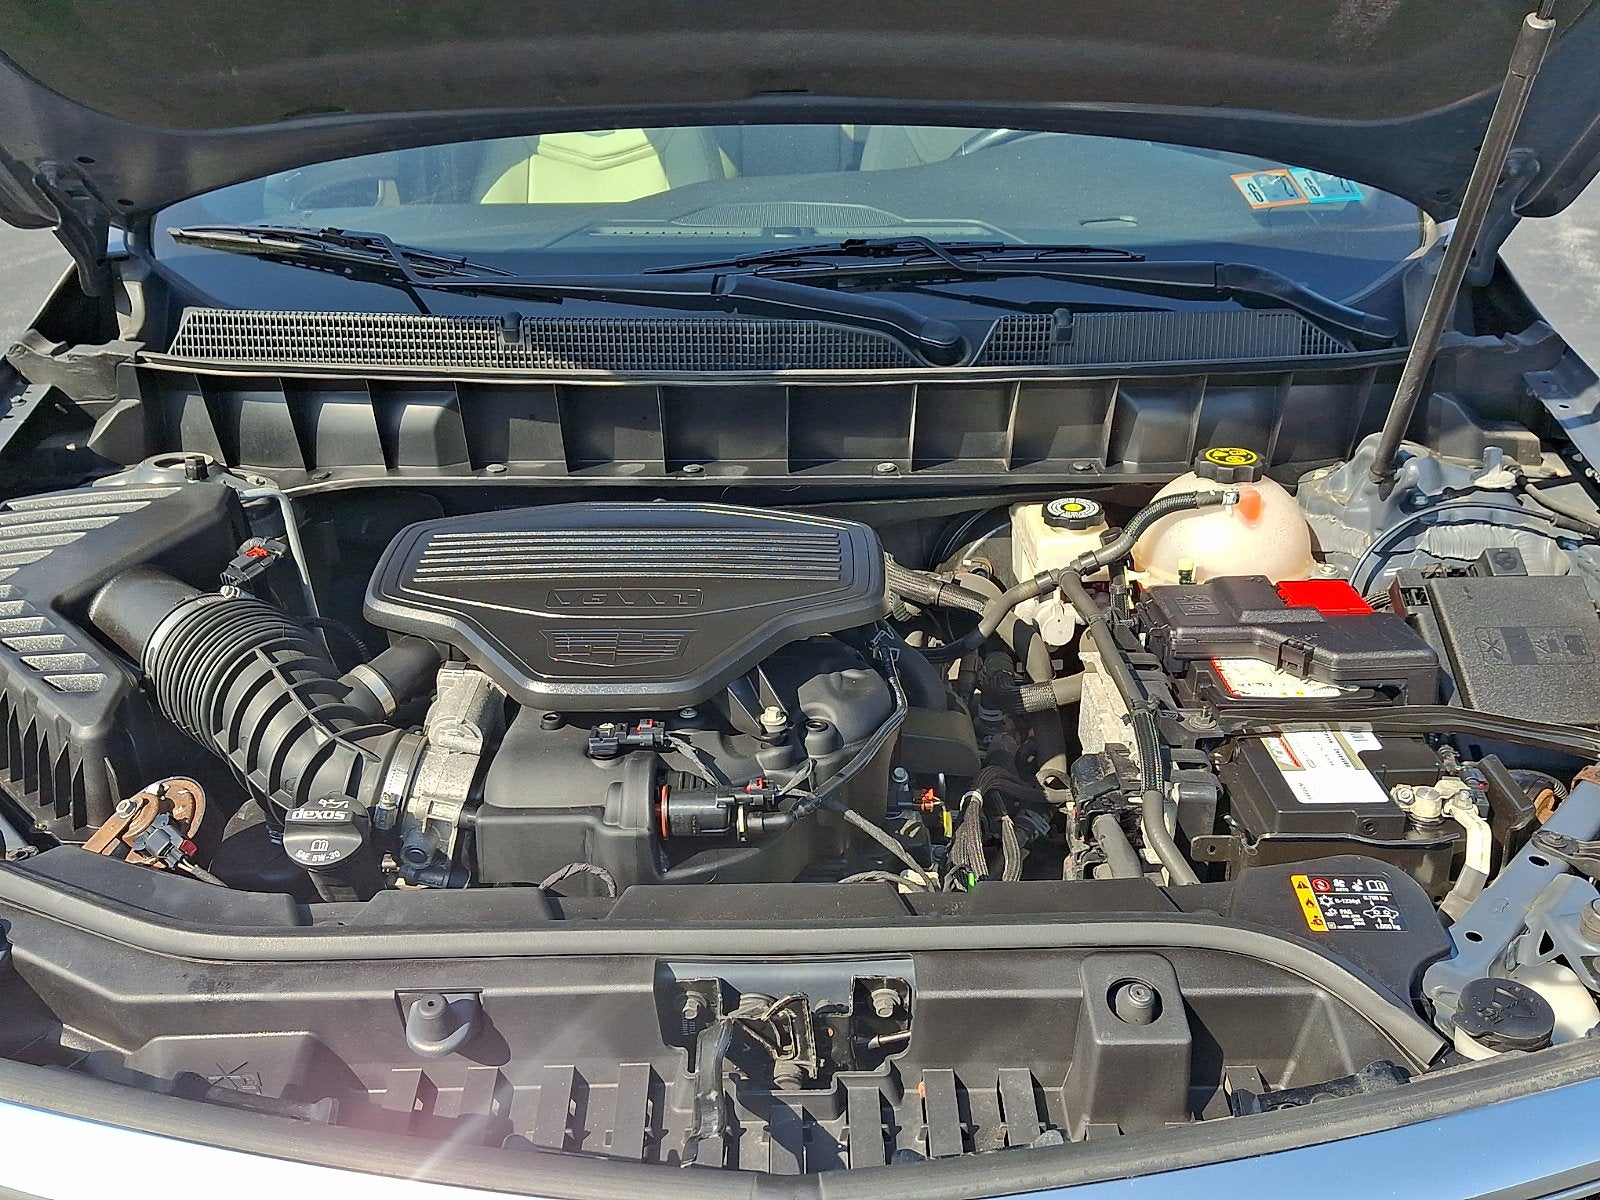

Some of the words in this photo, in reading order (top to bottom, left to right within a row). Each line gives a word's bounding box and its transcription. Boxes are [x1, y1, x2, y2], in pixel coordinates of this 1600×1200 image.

[292, 808, 348, 820] dexos
[295, 849, 311, 861] SAE
[312, 850, 341, 862] 5W-30
